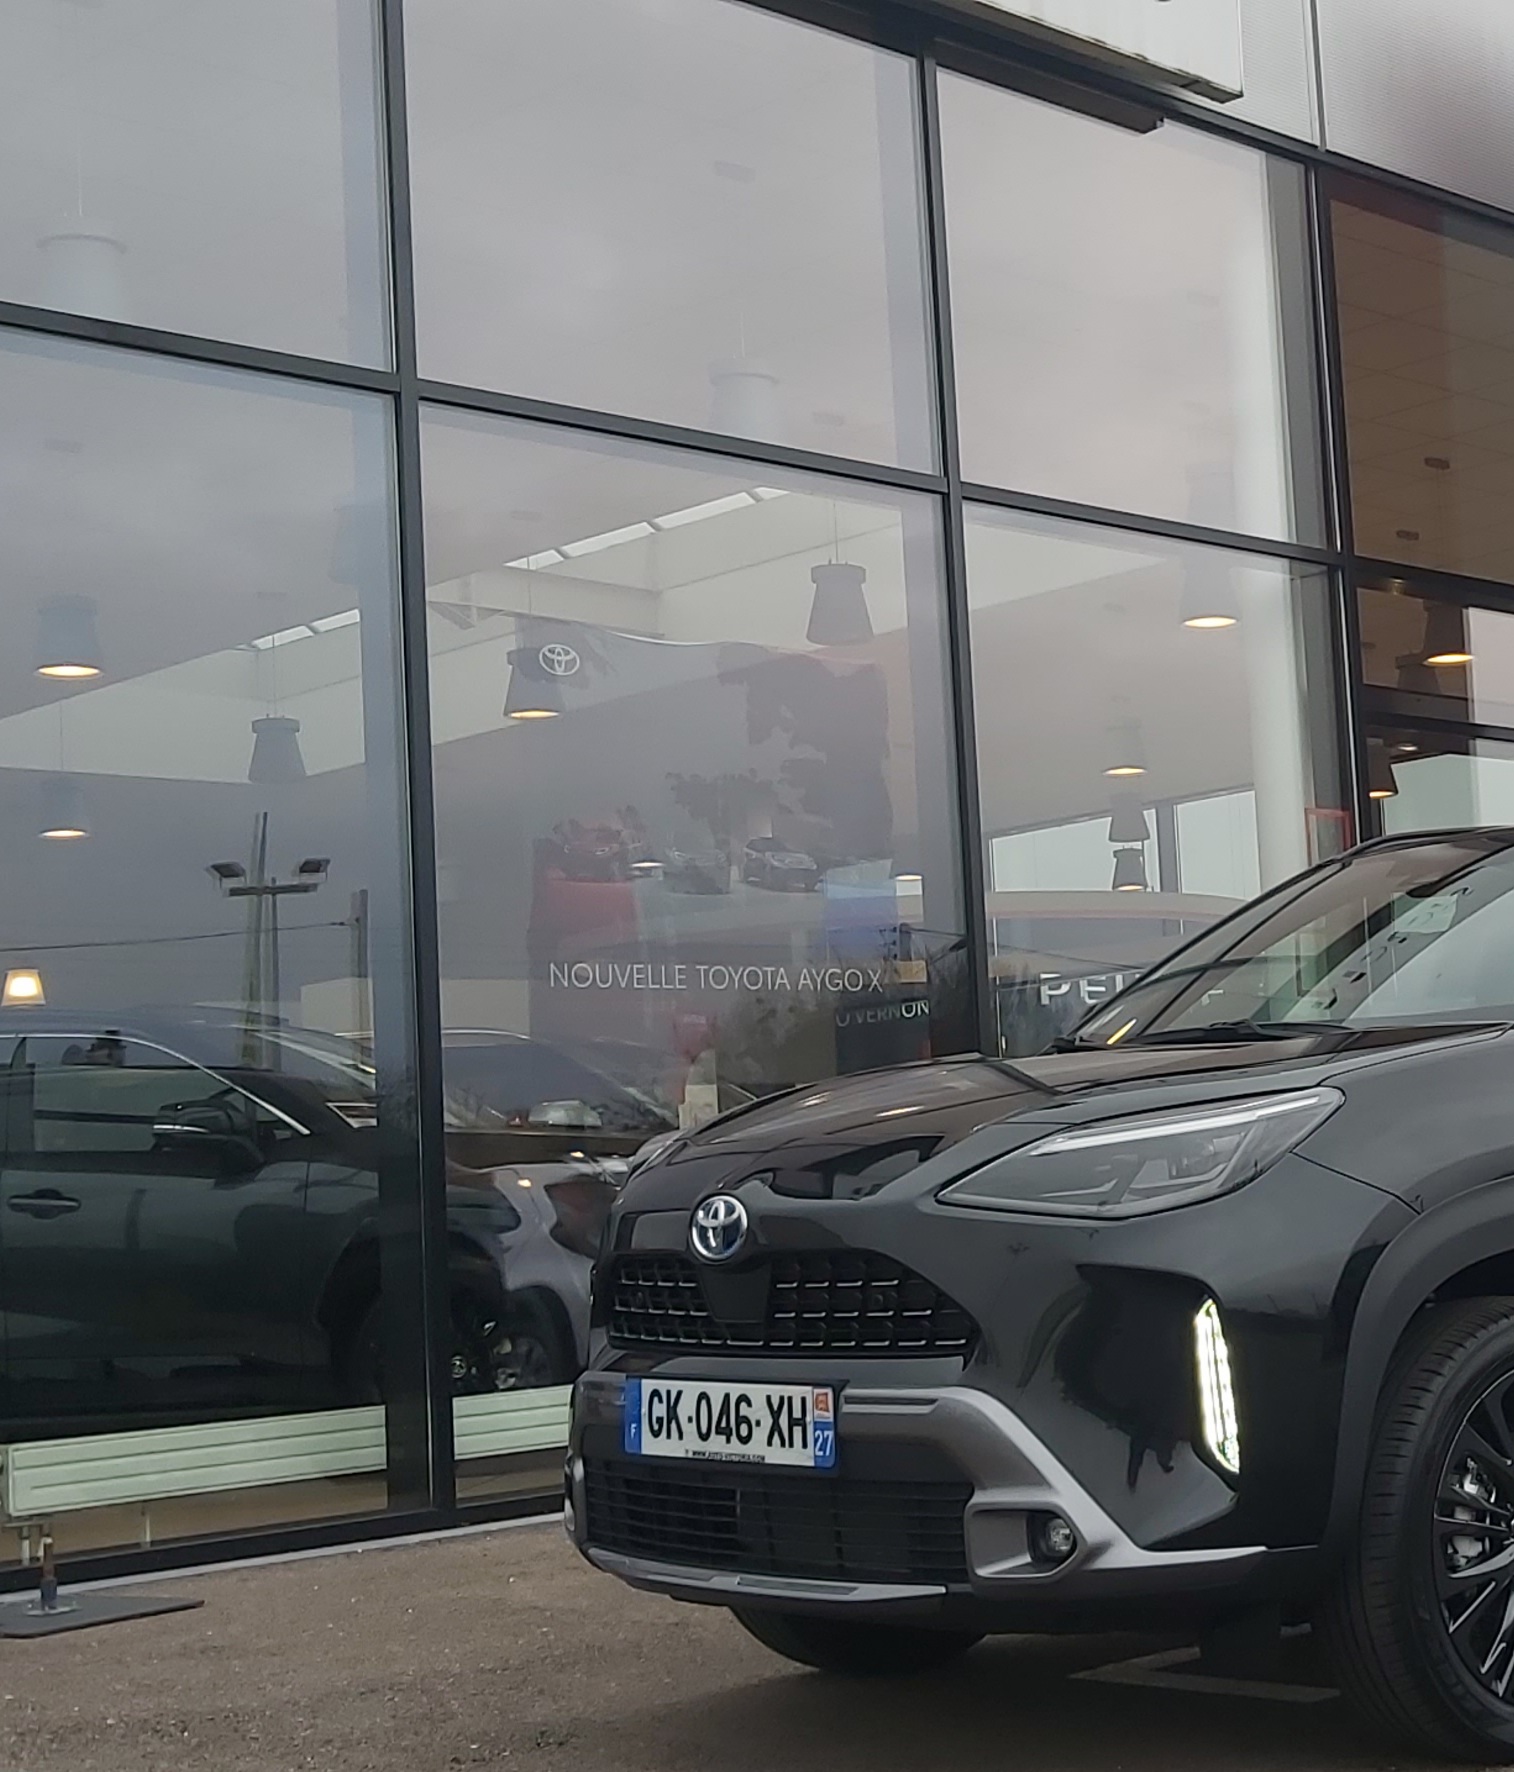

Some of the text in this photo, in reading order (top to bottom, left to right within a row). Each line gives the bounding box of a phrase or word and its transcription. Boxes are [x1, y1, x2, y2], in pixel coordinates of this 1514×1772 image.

[550, 963, 883, 993] NOUVELLE TOYOTA AYGO X
[630, 1423, 638, 1440] F
[815, 1430, 833, 1457] 27
